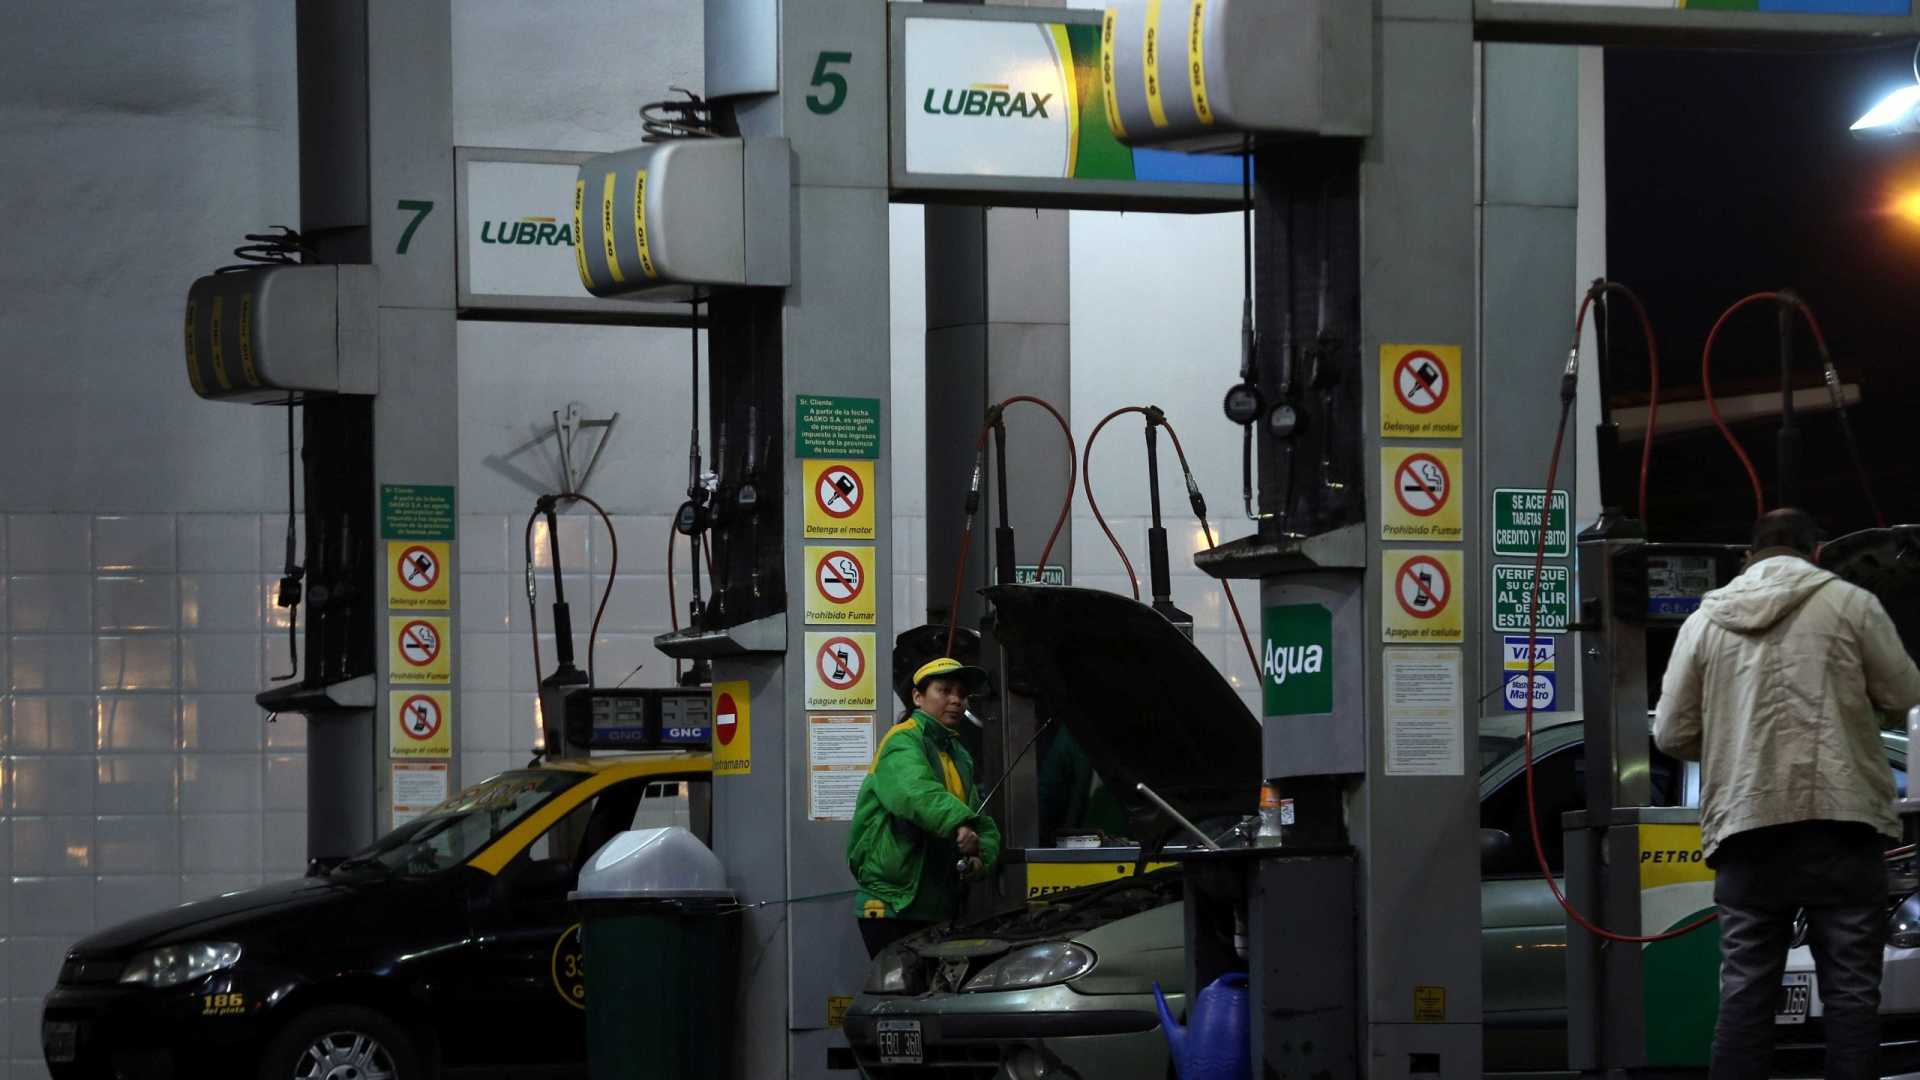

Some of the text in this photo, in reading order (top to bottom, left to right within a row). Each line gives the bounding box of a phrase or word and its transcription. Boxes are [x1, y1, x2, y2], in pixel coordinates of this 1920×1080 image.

[1192, 3, 1207, 115] Motor Oil 40
[805, 50, 852, 115] 5
[1148, 74, 1157, 96] 40
[923, 88, 1053, 119] LUBRAX
[396, 200, 434, 255] 7
[636, 177, 651, 271] Motor Oil 40
[481, 220, 575, 246] LUBRA
[607, 238, 614, 257] 40
[1383, 421, 1459, 433] Detenga el motor
[1512, 494, 1524, 510] SE
[1511, 511, 1542, 526] TARJETAS
[806, 524, 873, 535] Detenga el motor
[1383, 524, 1462, 535] Prohibido Fumar
[1496, 529, 1530, 546] CREDITO
[1530, 529, 1537, 545] Y
[1497, 568, 1566, 581] VERIFQUE
[1505, 581, 1556, 591] SU CAOT
[390, 597, 448, 607] Detenga el motor
[1498, 591, 1517, 604] AL
[806, 610, 875, 621] Prohibido Fumar
[1515, 604, 1531, 614] DE
[1384, 627, 1461, 639] Apague el celular
[1263, 638, 1324, 685] Agua
[390, 671, 450, 681] Prohibido Fumar
[807, 697, 875, 706] Apague el celular
[669, 728, 704, 738] GNC
[418, 746, 426, 754] el
[426, 746, 450, 754] celular
[203, 993, 244, 1009] 186
[1784, 987, 1807, 1014] 166
[202, 1007, 219, 1016] del
[904, 1032, 921, 1056] 360
